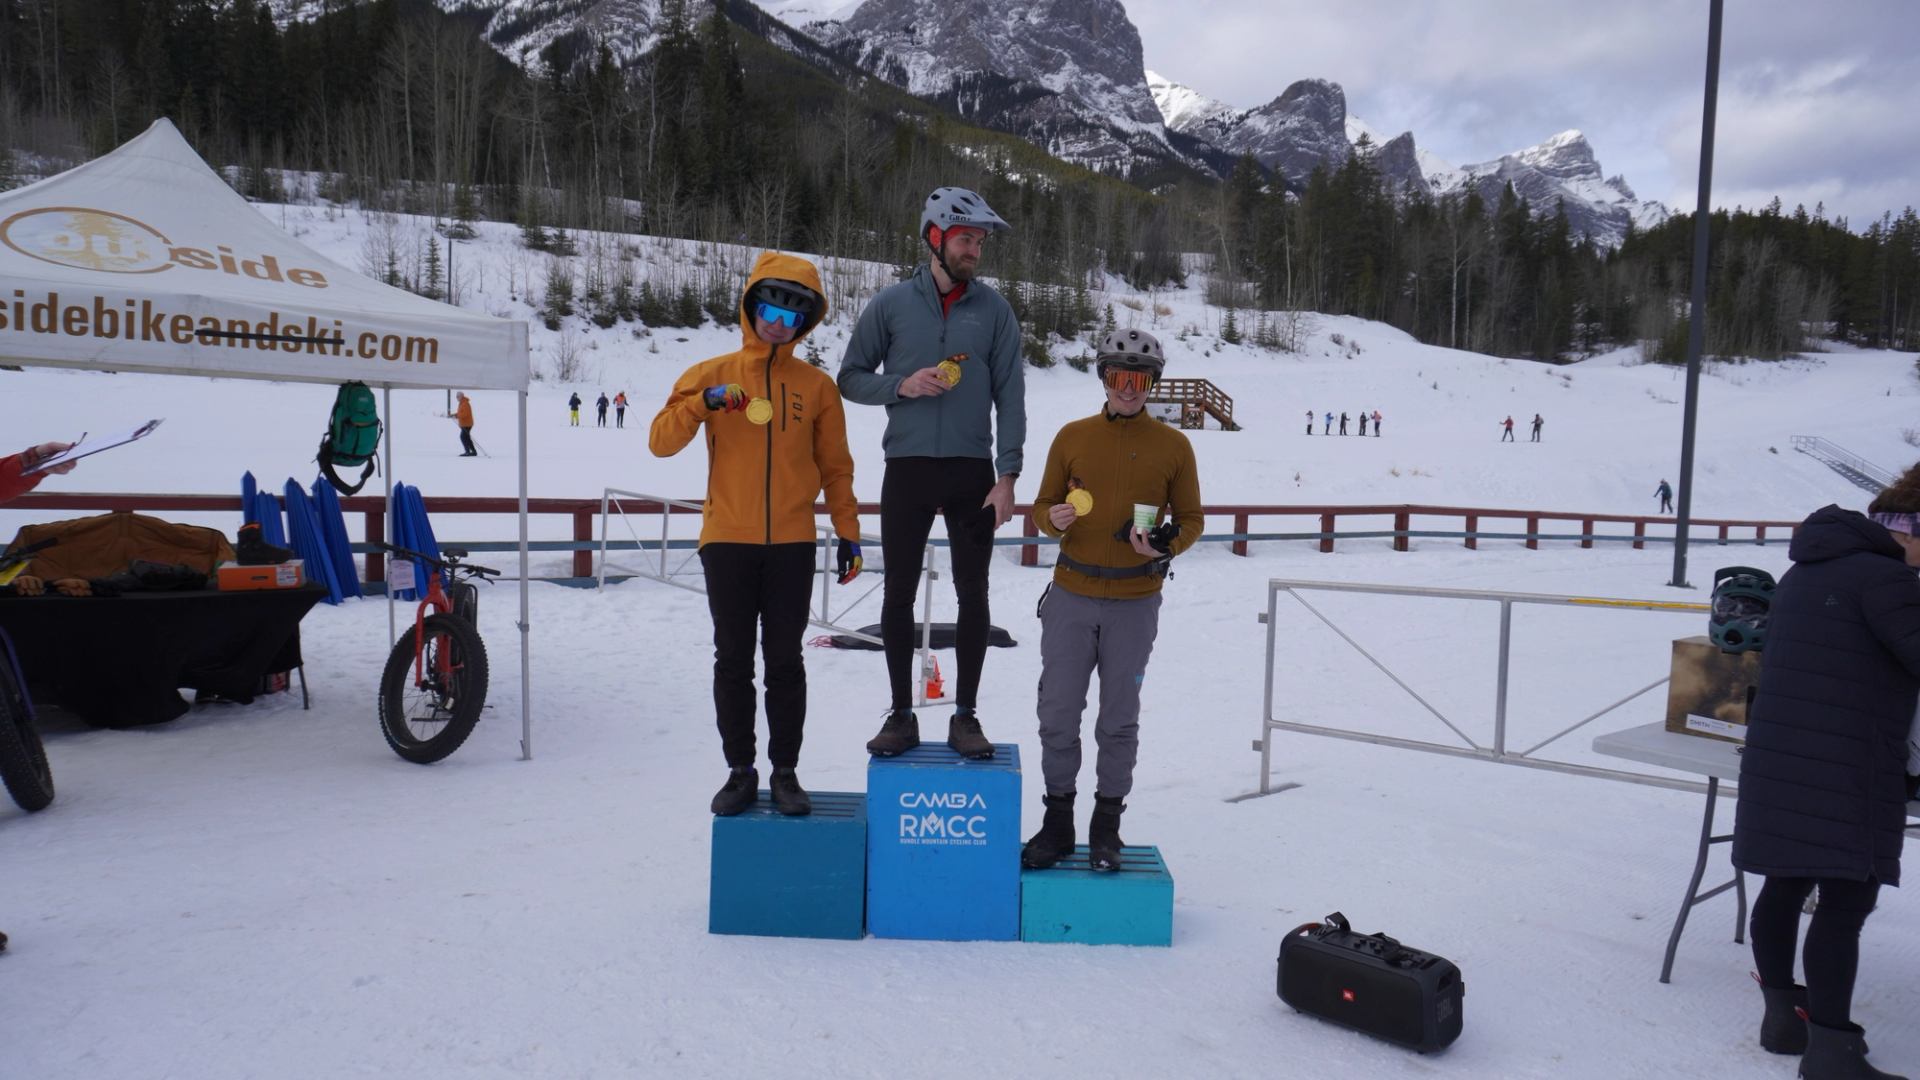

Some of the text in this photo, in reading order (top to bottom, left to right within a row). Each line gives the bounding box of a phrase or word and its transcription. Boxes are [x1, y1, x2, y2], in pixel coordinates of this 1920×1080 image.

[792, 392, 803, 424] FOX
[900, 792, 987, 809] CAMBA
[900, 812, 987, 838] RMCC
